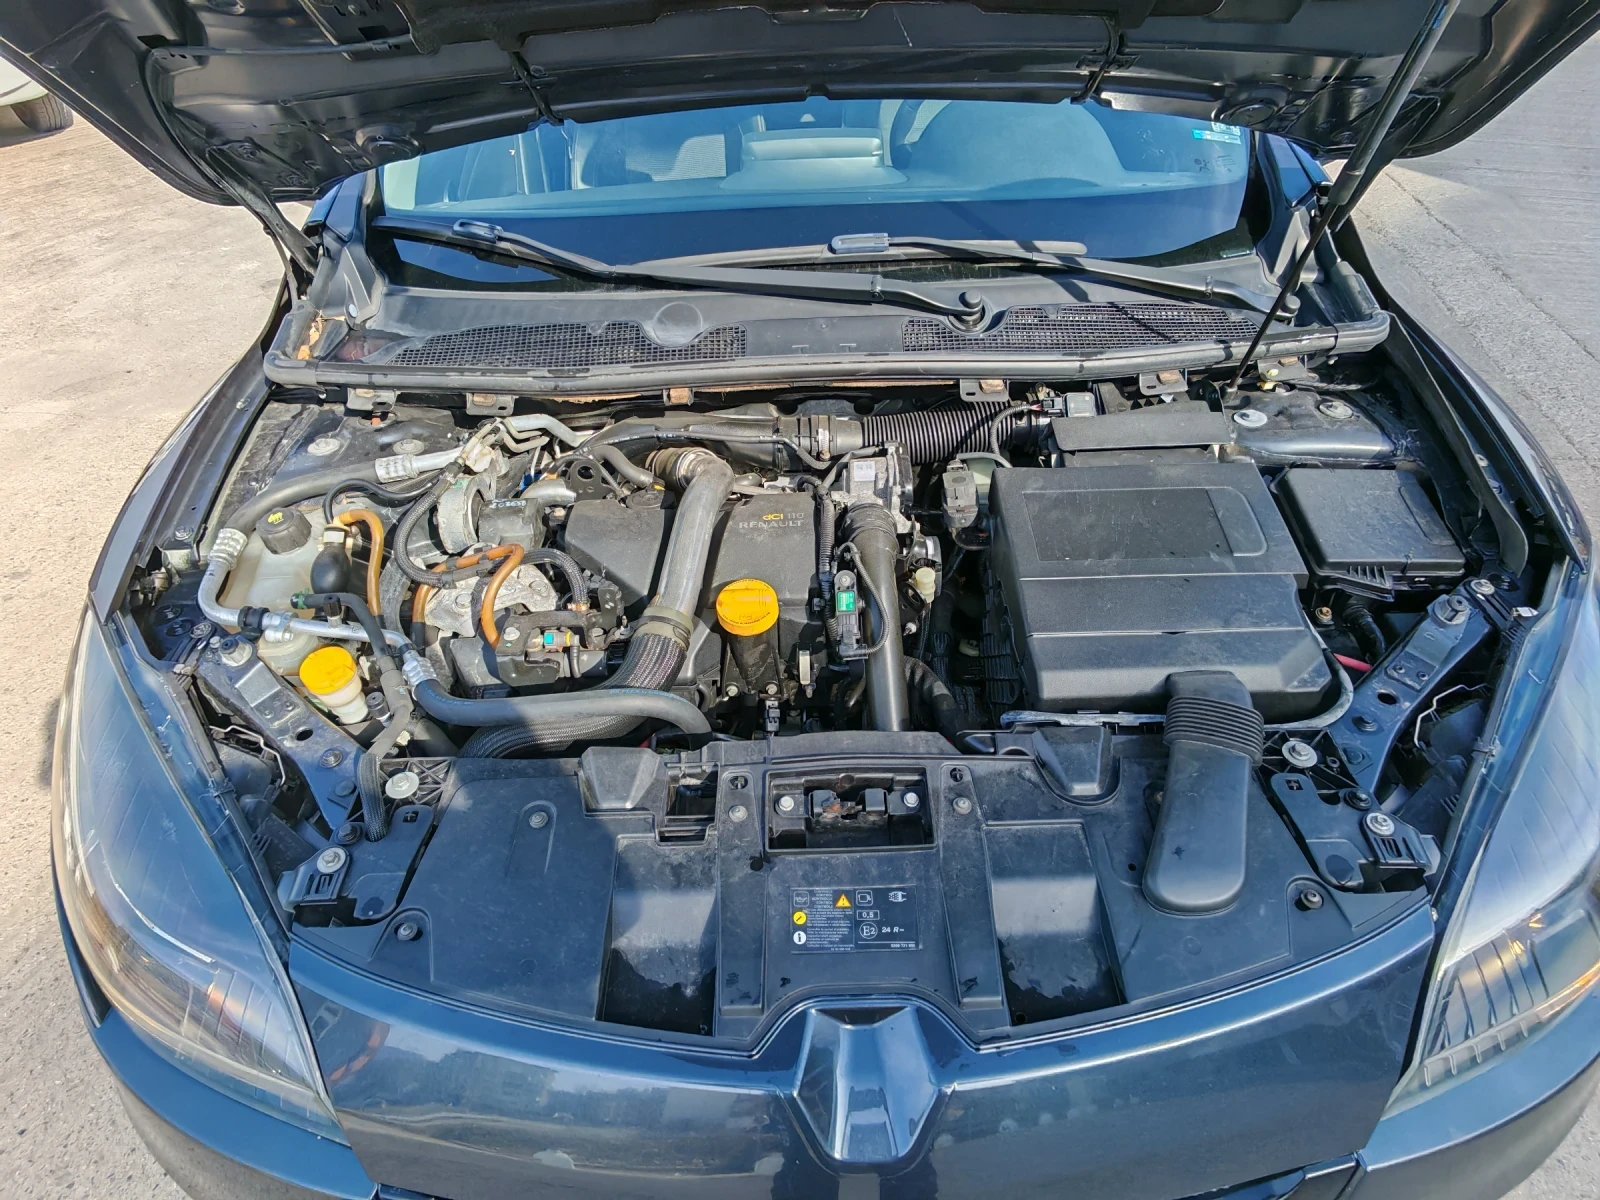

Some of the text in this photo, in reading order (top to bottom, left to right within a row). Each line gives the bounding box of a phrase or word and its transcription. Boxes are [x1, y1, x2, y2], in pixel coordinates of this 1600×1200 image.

[739, 520, 804, 528] RENAULT
[862, 911, 874, 919] 0,5
[863, 925, 876, 936] E2
